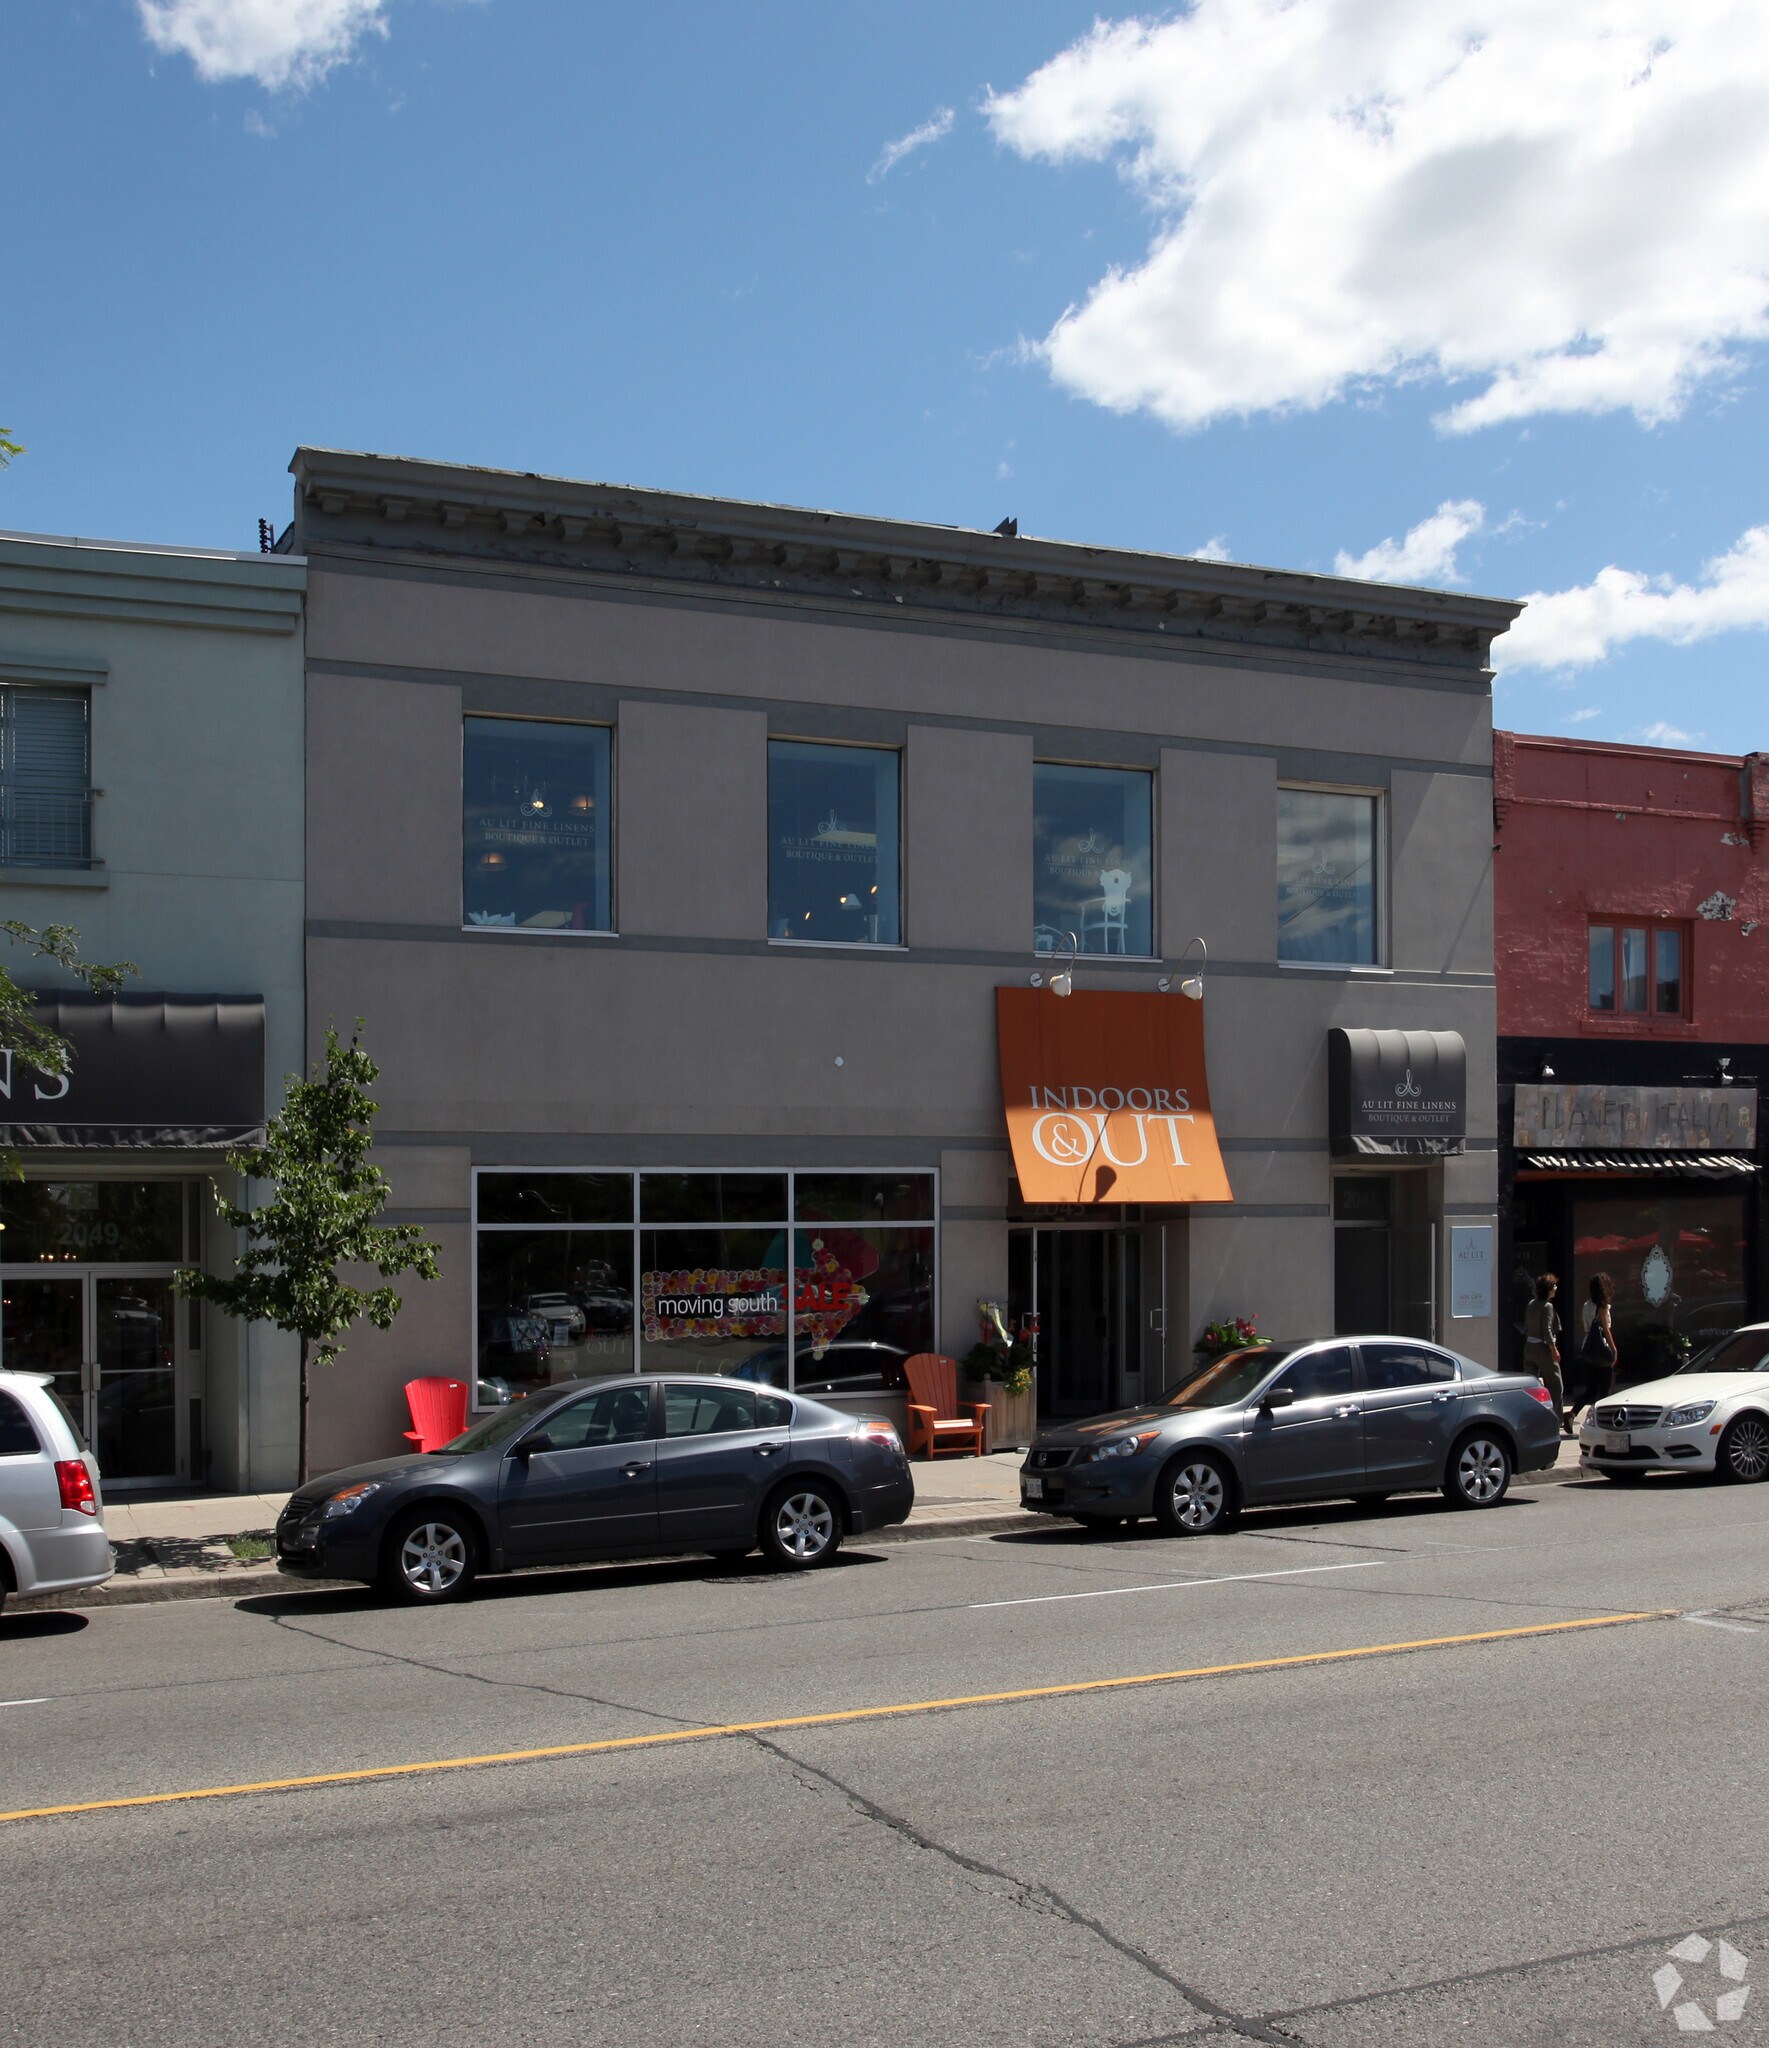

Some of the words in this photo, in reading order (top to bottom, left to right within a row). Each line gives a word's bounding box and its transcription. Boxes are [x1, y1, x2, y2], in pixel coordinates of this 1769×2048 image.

[480, 818, 494, 827] AU
[499, 819, 518, 828] LIT
[522, 820, 549, 830] FINE
[553, 823, 595, 833] LINENS
[485, 832, 539, 845] BOUTIQUE
[549, 836, 589, 846] OUTLET
[780, 836, 795, 845] AU
[799, 838, 815, 846] LIT
[786, 850, 833, 861] BOUTIQUE
[844, 854, 880, 864] OUTLET
[1028, 1085, 1190, 1112] INDOORS
[1362, 1100, 1375, 1109] AU
[1378, 1101, 1394, 1109] LIT
[1396, 1101, 1419, 1109] FINE
[1421, 1101, 1457, 1110] LINENS
[1368, 1113, 1410, 1124] BOUTIQUE
[1418, 1114, 1450, 1123] OUTLET
[1542, 1093, 1632, 1131] PLANET
[1654, 1093, 1730, 1131] ITALIA
[1032, 1112, 1195, 1167] OUT
[58, 1222, 119, 1246] 2049
[658, 1295, 724, 1318] moving
[728, 1291, 777, 1313] south
[780, 1282, 849, 1311] SALE
